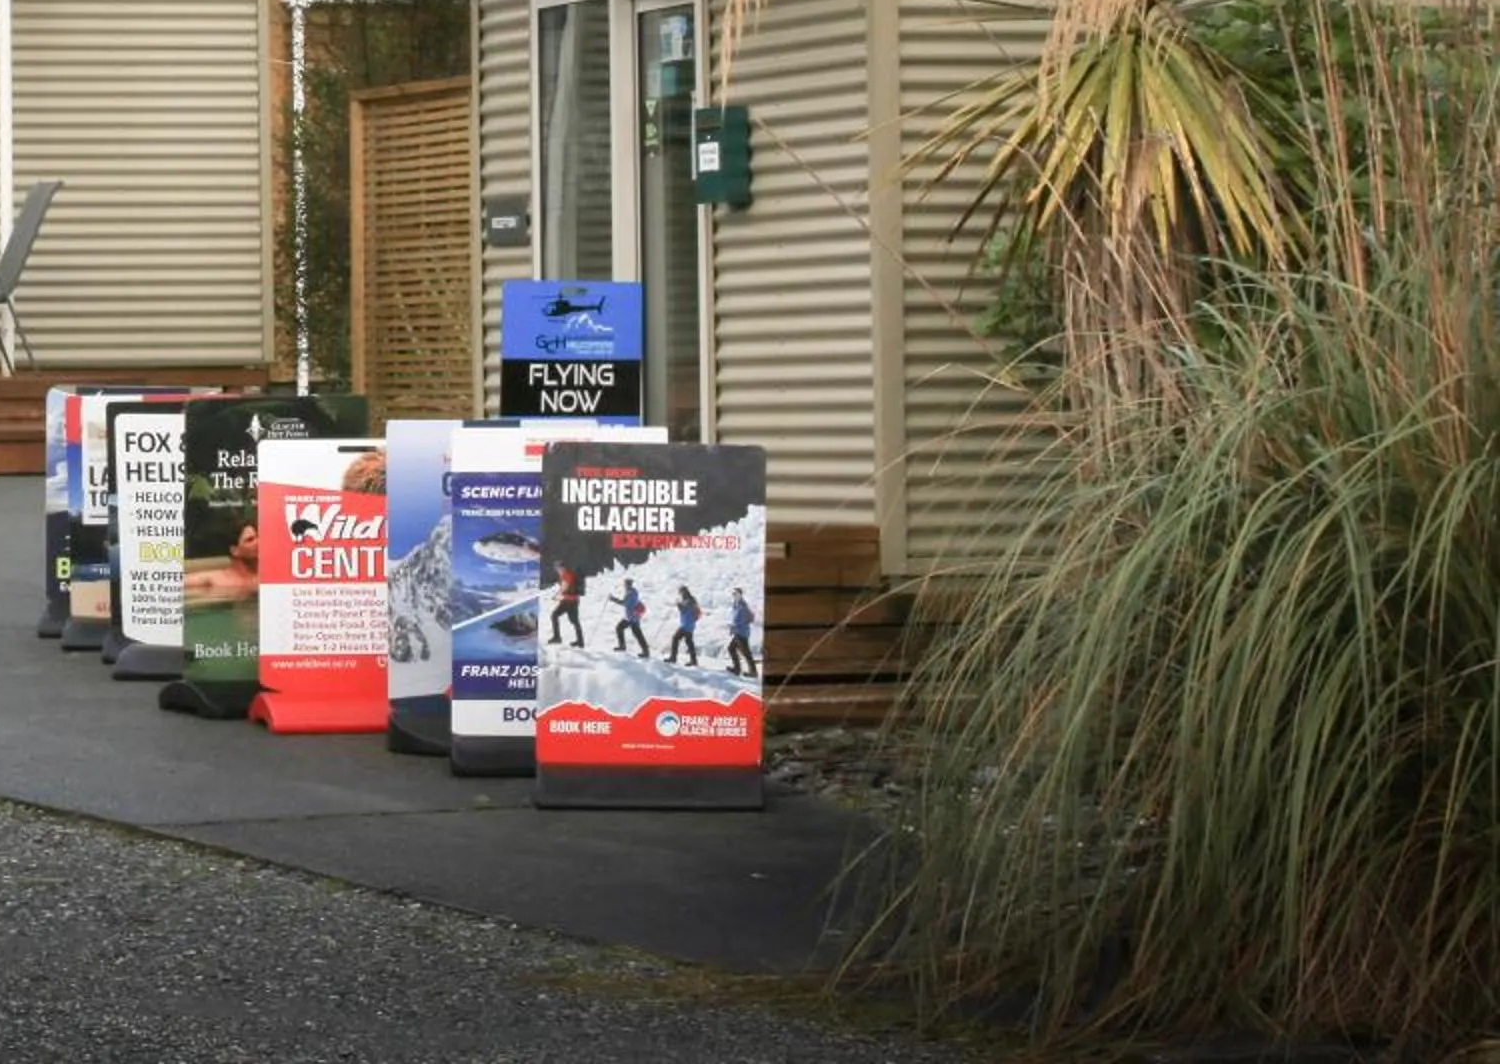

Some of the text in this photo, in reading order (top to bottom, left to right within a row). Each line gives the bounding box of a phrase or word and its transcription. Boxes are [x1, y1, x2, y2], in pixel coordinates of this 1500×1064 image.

[529, 363, 615, 386] FLYING
[540, 389, 602, 413] NOW
[125, 431, 171, 453] FOX
[217, 450, 258, 468] Rela
[211, 472, 245, 489] The
[462, 486, 543, 499] SCENIC FLI
[561, 477, 698, 505] INCREDIBLE
[135, 508, 179, 521] SNOW
[577, 506, 676, 533] GLACIER
[291, 546, 388, 579] CENT
[195, 641, 232, 658] Book
[461, 665, 510, 677] FRANZ
[550, 719, 613, 735] BOOK HERE
[681, 715, 711, 726] FRANZ
